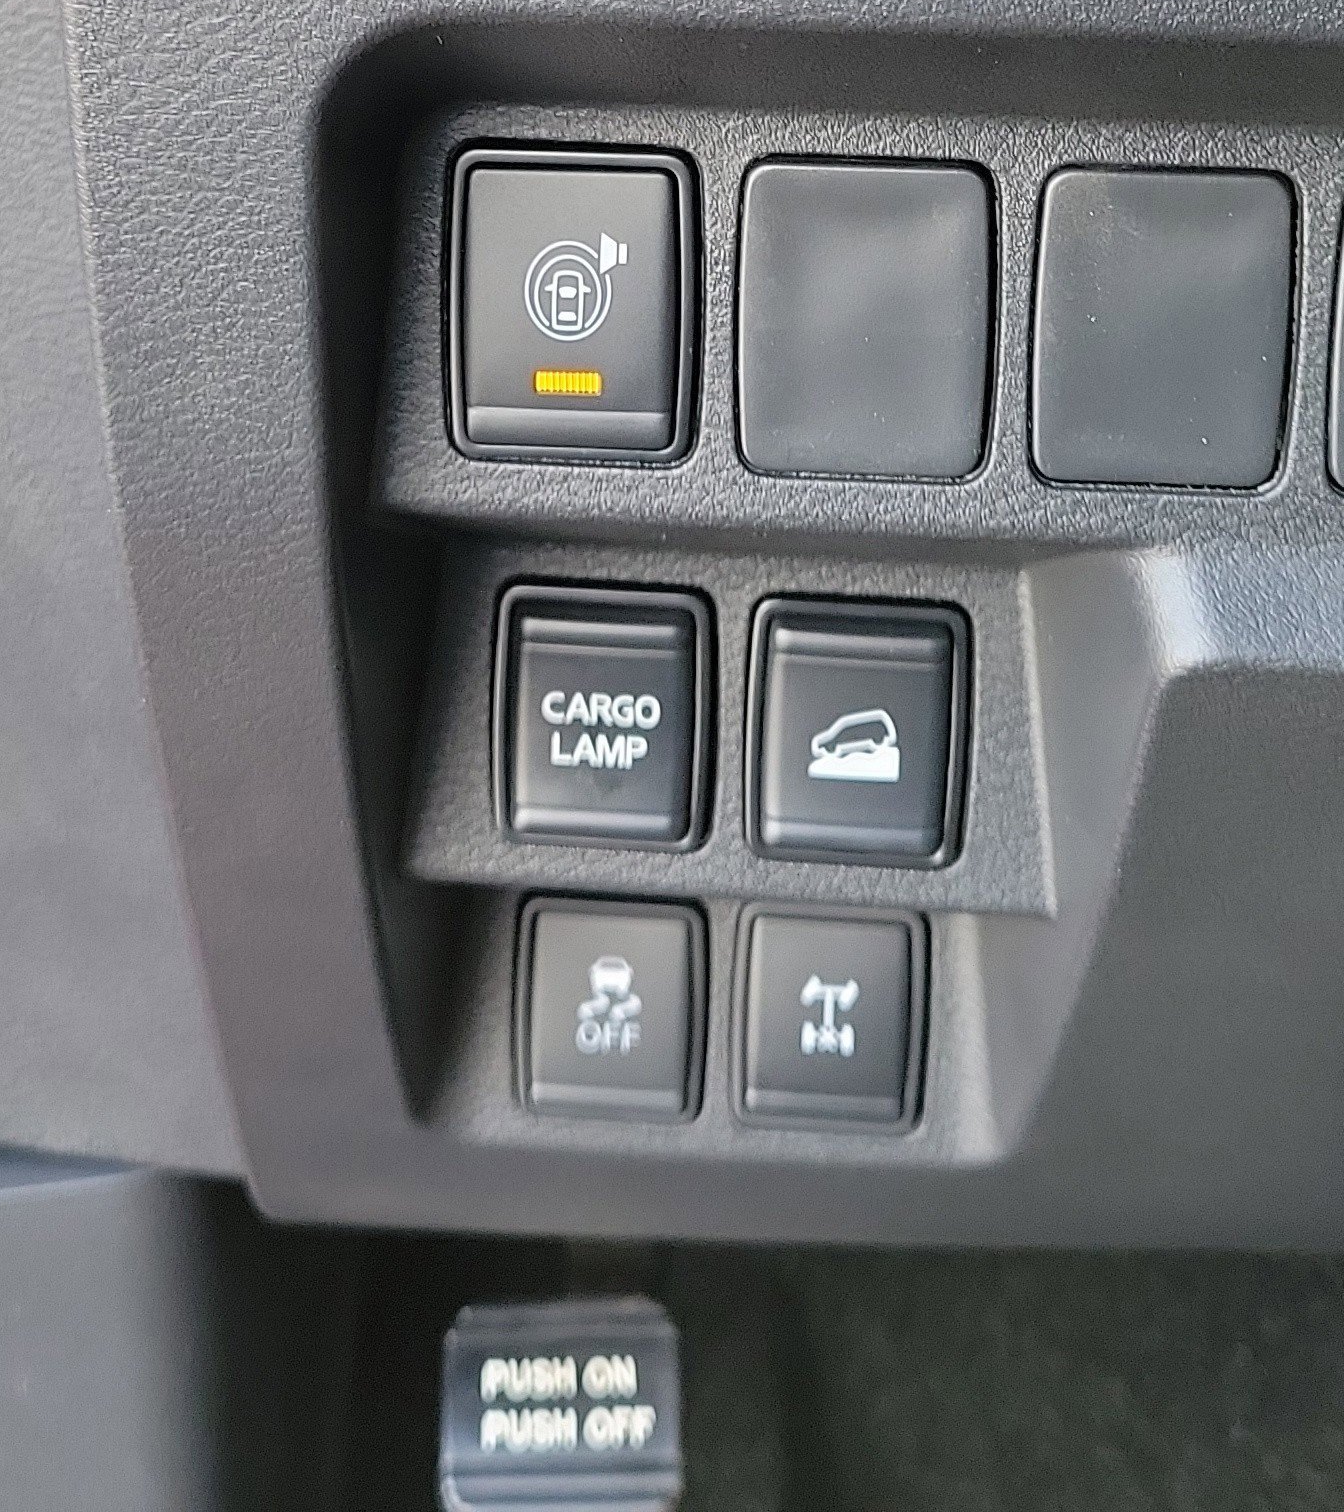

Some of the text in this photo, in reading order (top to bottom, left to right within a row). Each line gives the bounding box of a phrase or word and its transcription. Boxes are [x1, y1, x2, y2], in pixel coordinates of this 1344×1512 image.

[541, 690, 661, 729] CARGO
[550, 731, 648, 770] LAMP
[575, 1021, 641, 1054] OFF
[480, 1354, 638, 1402] PUSH ON
[480, 1404, 656, 1453] PUSH OFF
